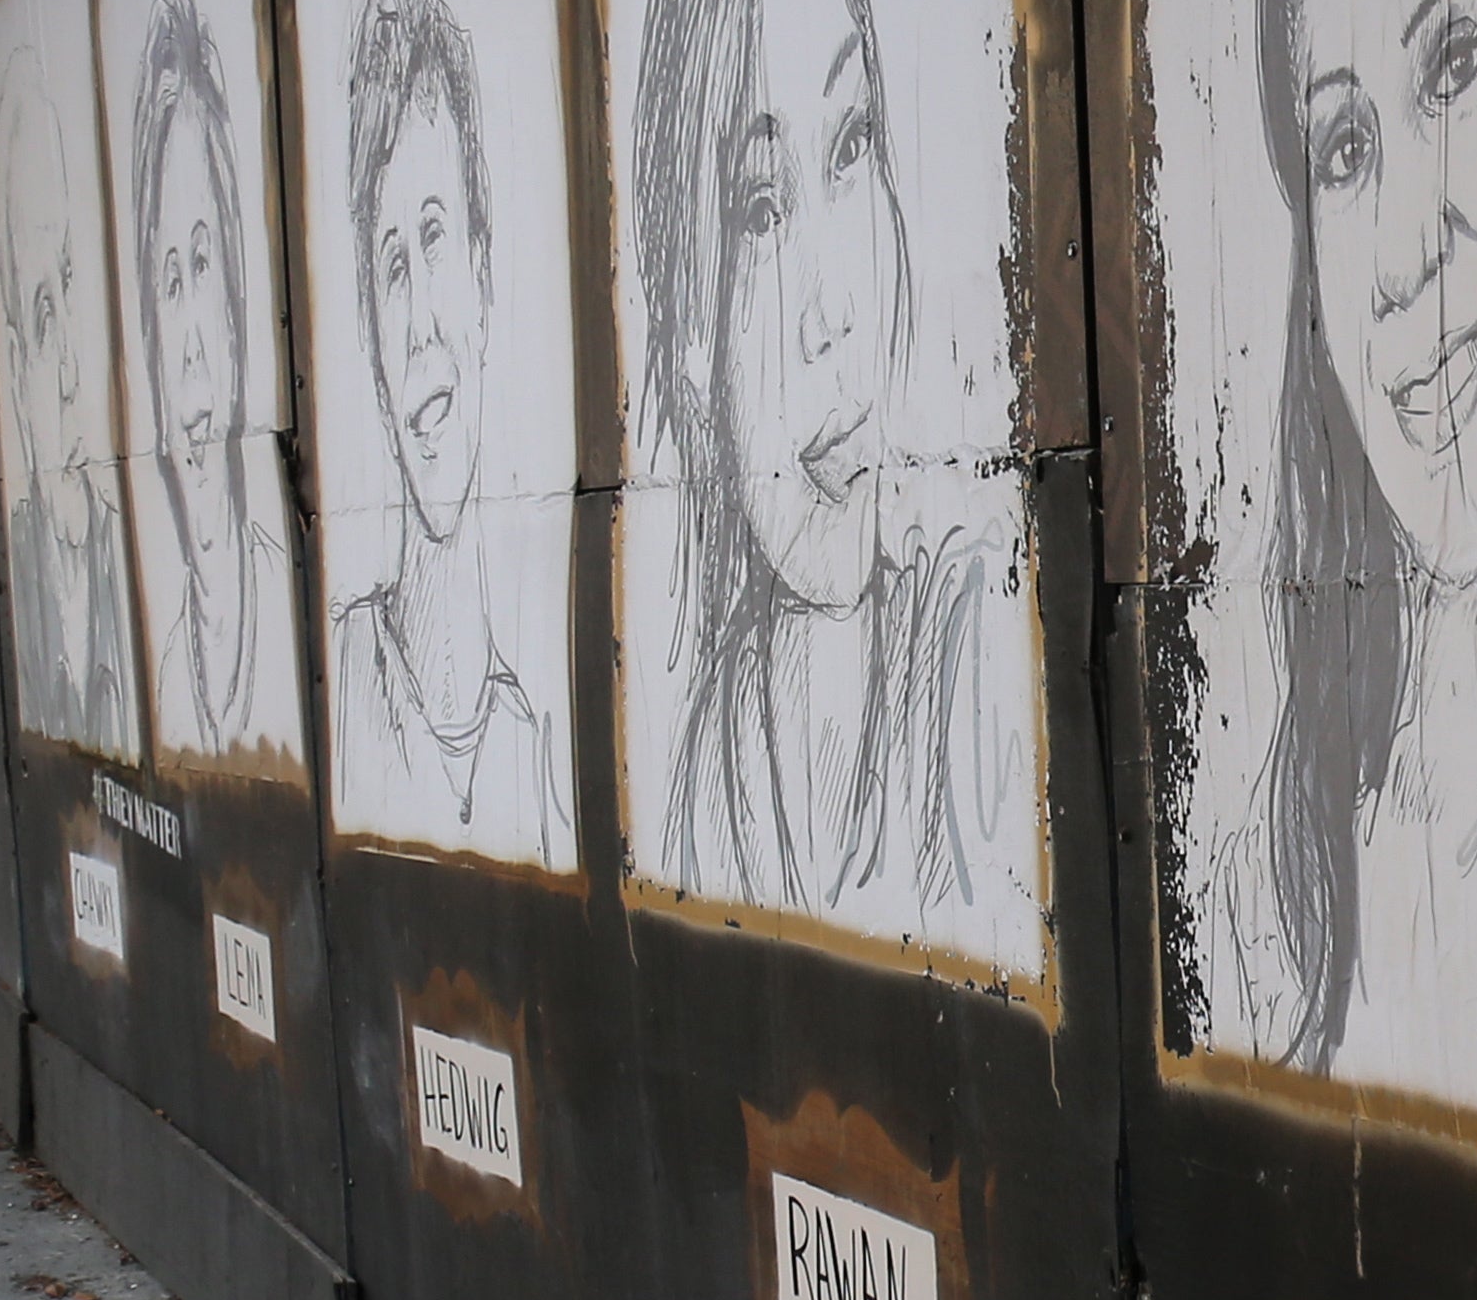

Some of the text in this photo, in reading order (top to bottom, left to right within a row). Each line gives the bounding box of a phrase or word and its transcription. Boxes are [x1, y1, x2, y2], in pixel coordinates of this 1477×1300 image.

[92, 768, 182, 859] #THEYMATTER
[224, 933, 266, 1018] LENA
[422, 1047, 510, 1157] HEDWIG
